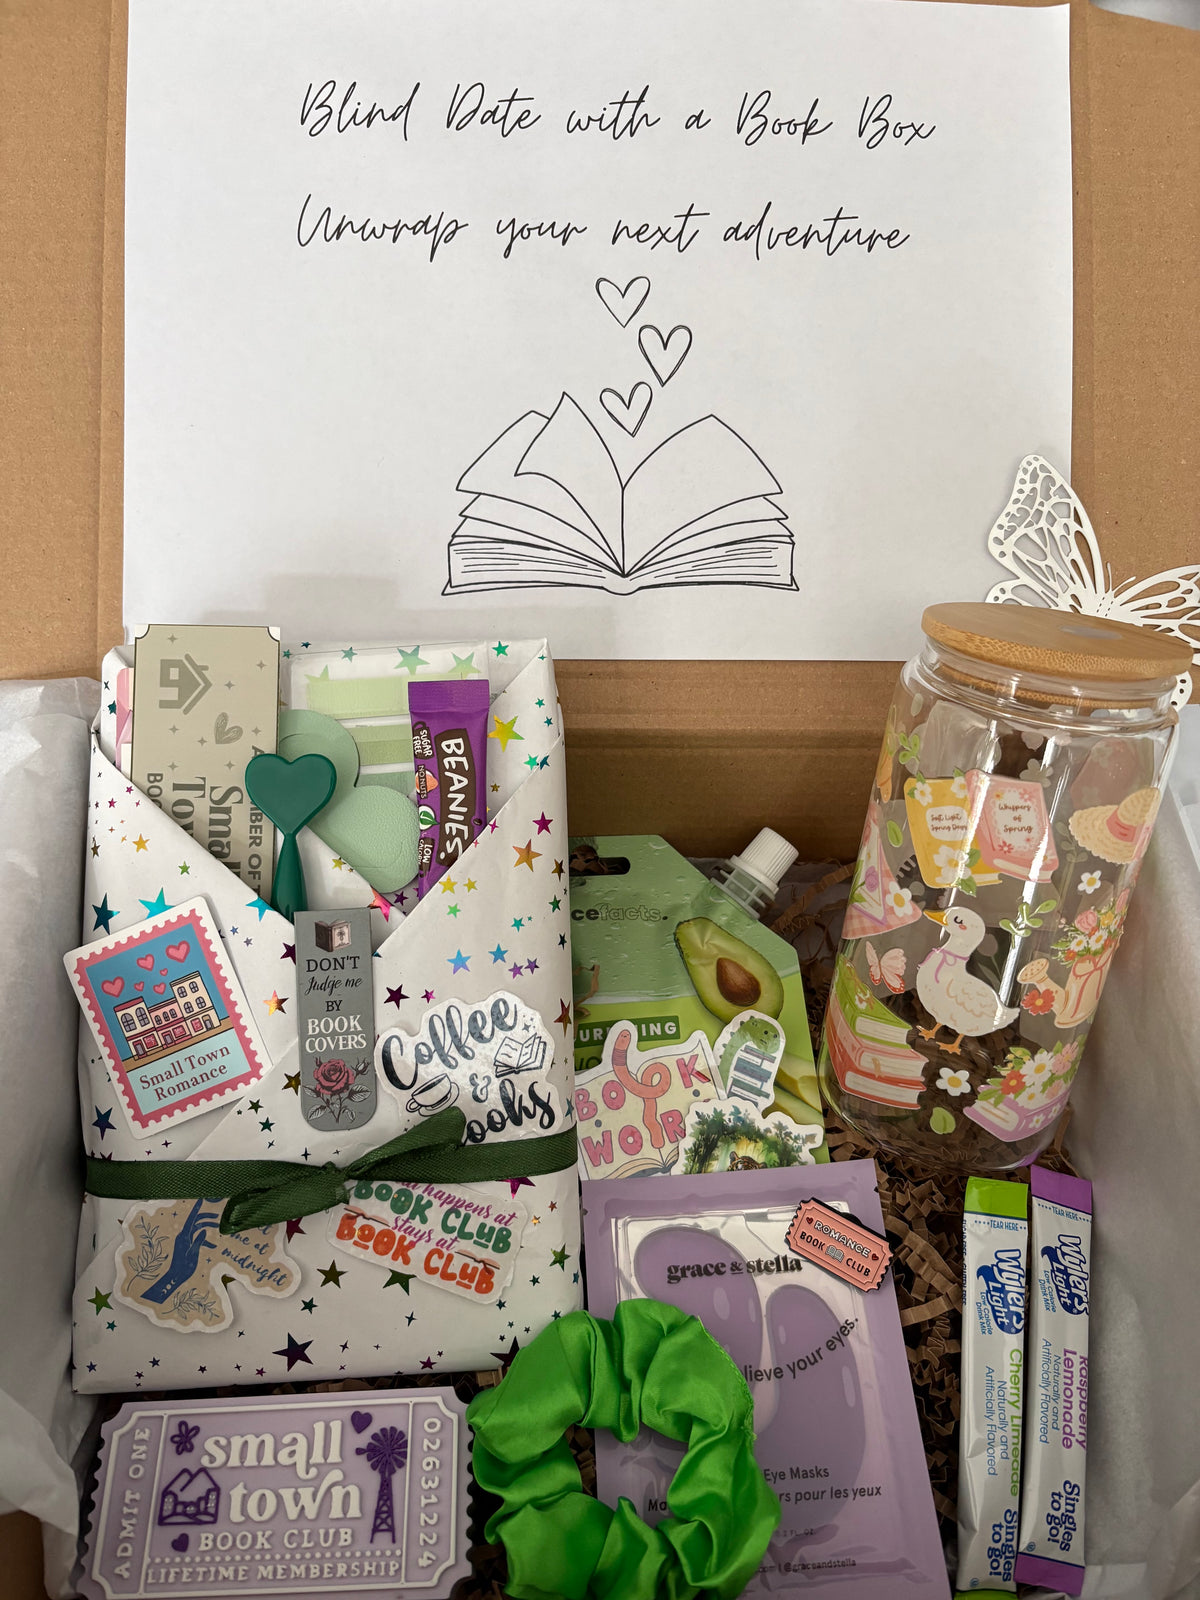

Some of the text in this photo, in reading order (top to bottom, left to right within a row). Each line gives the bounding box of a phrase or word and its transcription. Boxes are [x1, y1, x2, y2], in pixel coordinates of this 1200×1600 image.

[300, 80, 937, 150] Blind Date with a Book Box
[297, 193, 911, 263] Unwrap your next adventure
[412, 736, 423, 755] FREE
[419, 729, 433, 757] SUGAR
[207, 786, 244, 878] Sma
[1003, 825, 1034, 834] Spring
[1012, 814, 1022, 822] of
[248, 853, 262, 881] OF
[422, 844, 433, 864] LOW
[305, 955, 361, 973] DON'T
[344, 976, 364, 988] me
[307, 1014, 363, 1036] BOOK
[325, 999, 343, 1012] BY
[305, 1033, 368, 1053] COVERS
[381, 997, 518, 1091] Coffee
[139, 1046, 231, 1090] Small Town
[153, 1064, 228, 1102] Romance
[468, 1072, 492, 1104] &
[460, 1078, 556, 1146] ooks
[581, 1109, 687, 1168] WOR
[421, 1183, 518, 1228] happens at
[989, 1219, 1019, 1232] TEAR HERE
[1051, 1206, 1080, 1221] TEAR HERE
[253, 1242, 270, 1256] at
[391, 1215, 461, 1252] stays at
[799, 1230, 871, 1277] BOOK CLUB
[813, 1219, 872, 1258] ROMANCE
[220, 1247, 288, 1287] midnight
[666, 1254, 803, 1285] grace & stella
[1050, 1260, 1073, 1306] Light
[987, 1280, 1010, 1327] Light
[741, 1317, 859, 1383] lieve your eyes.
[1006, 1348, 1023, 1410] Cherry
[1039, 1338, 1052, 1444] Artificially Flavored
[1051, 1354, 1062, 1431] Naturally and
[1062, 1348, 1078, 1450] Lemonade
[985, 1365, 998, 1476] Artificially Flavored
[997, 1380, 1010, 1460] Naturally and
[1075, 1355, 1088, 1451] Raspberry
[200, 1419, 344, 1481] small
[229, 1468, 362, 1524] town
[763, 1464, 830, 1485] Eye Masks
[794, 1491, 827, 1505] pour
[829, 1485, 849, 1500] les
[851, 1484, 883, 1501] yeux
[114, 1427, 151, 1580] ADMIT ONE
[1046, 1490, 1064, 1544] to go!
[1059, 1479, 1081, 1552] Singles
[199, 1527, 354, 1552] BOOK CLUB
[987, 1522, 1004, 1577] to go!
[1000, 1508, 1018, 1583] Singles
[147, 1561, 401, 1585] LIFETIME MEMBERSHIP
